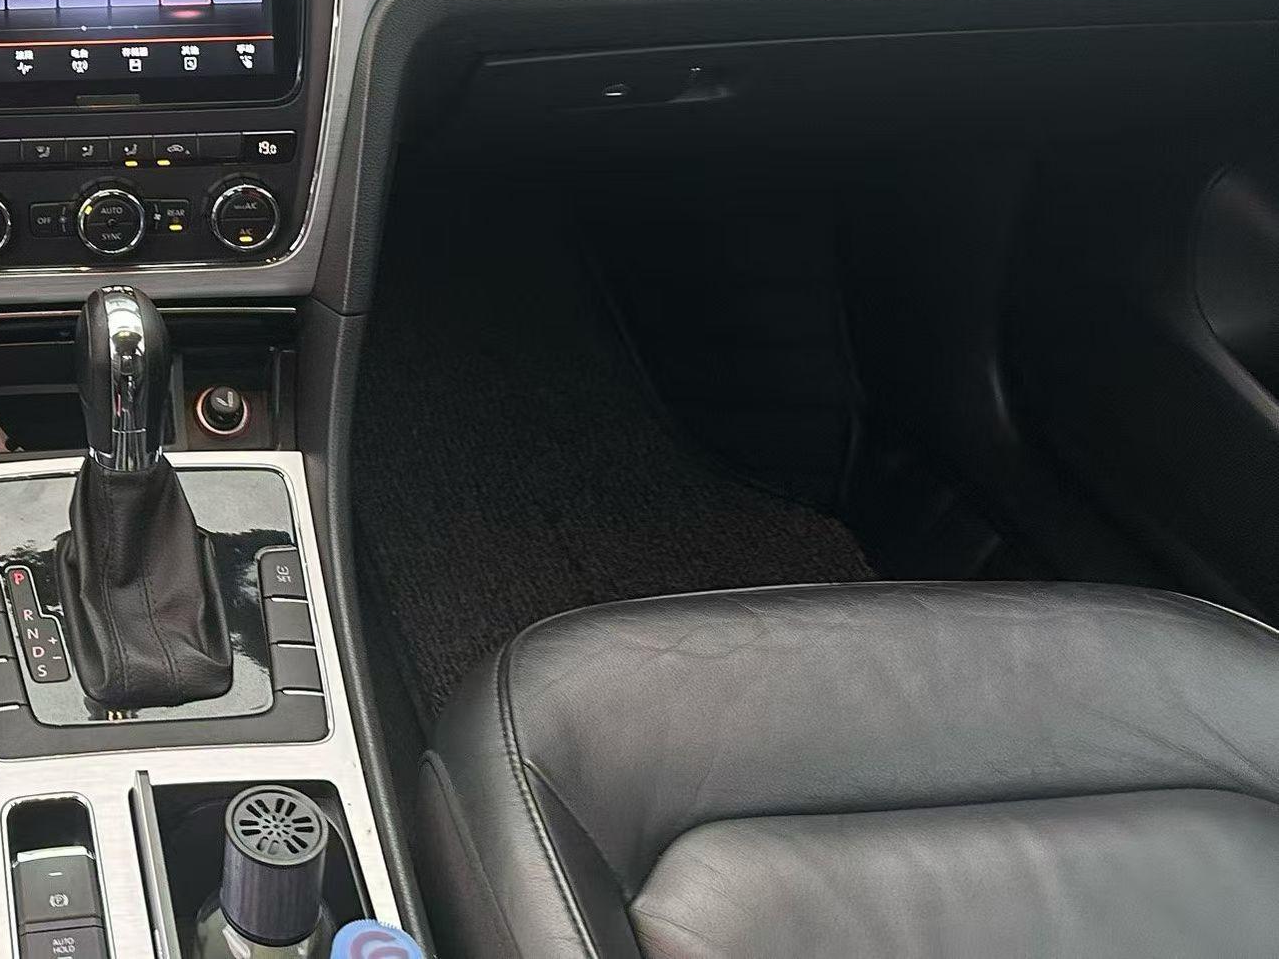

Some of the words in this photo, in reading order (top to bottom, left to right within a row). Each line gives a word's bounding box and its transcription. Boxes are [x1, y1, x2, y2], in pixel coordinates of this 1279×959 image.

[100, 207, 123, 215] AUTO
[37, 216, 52, 225] OFF
[101, 232, 122, 241] SYNC
[13, 572, 25, 585] P
[23, 609, 34, 621] R
[27, 628, 39, 640] N
[32, 646, 45, 658] D
[37, 664, 48, 677] S
[52, 937, 75, 946] AUTO
[52, 945, 76, 953] HOLD
